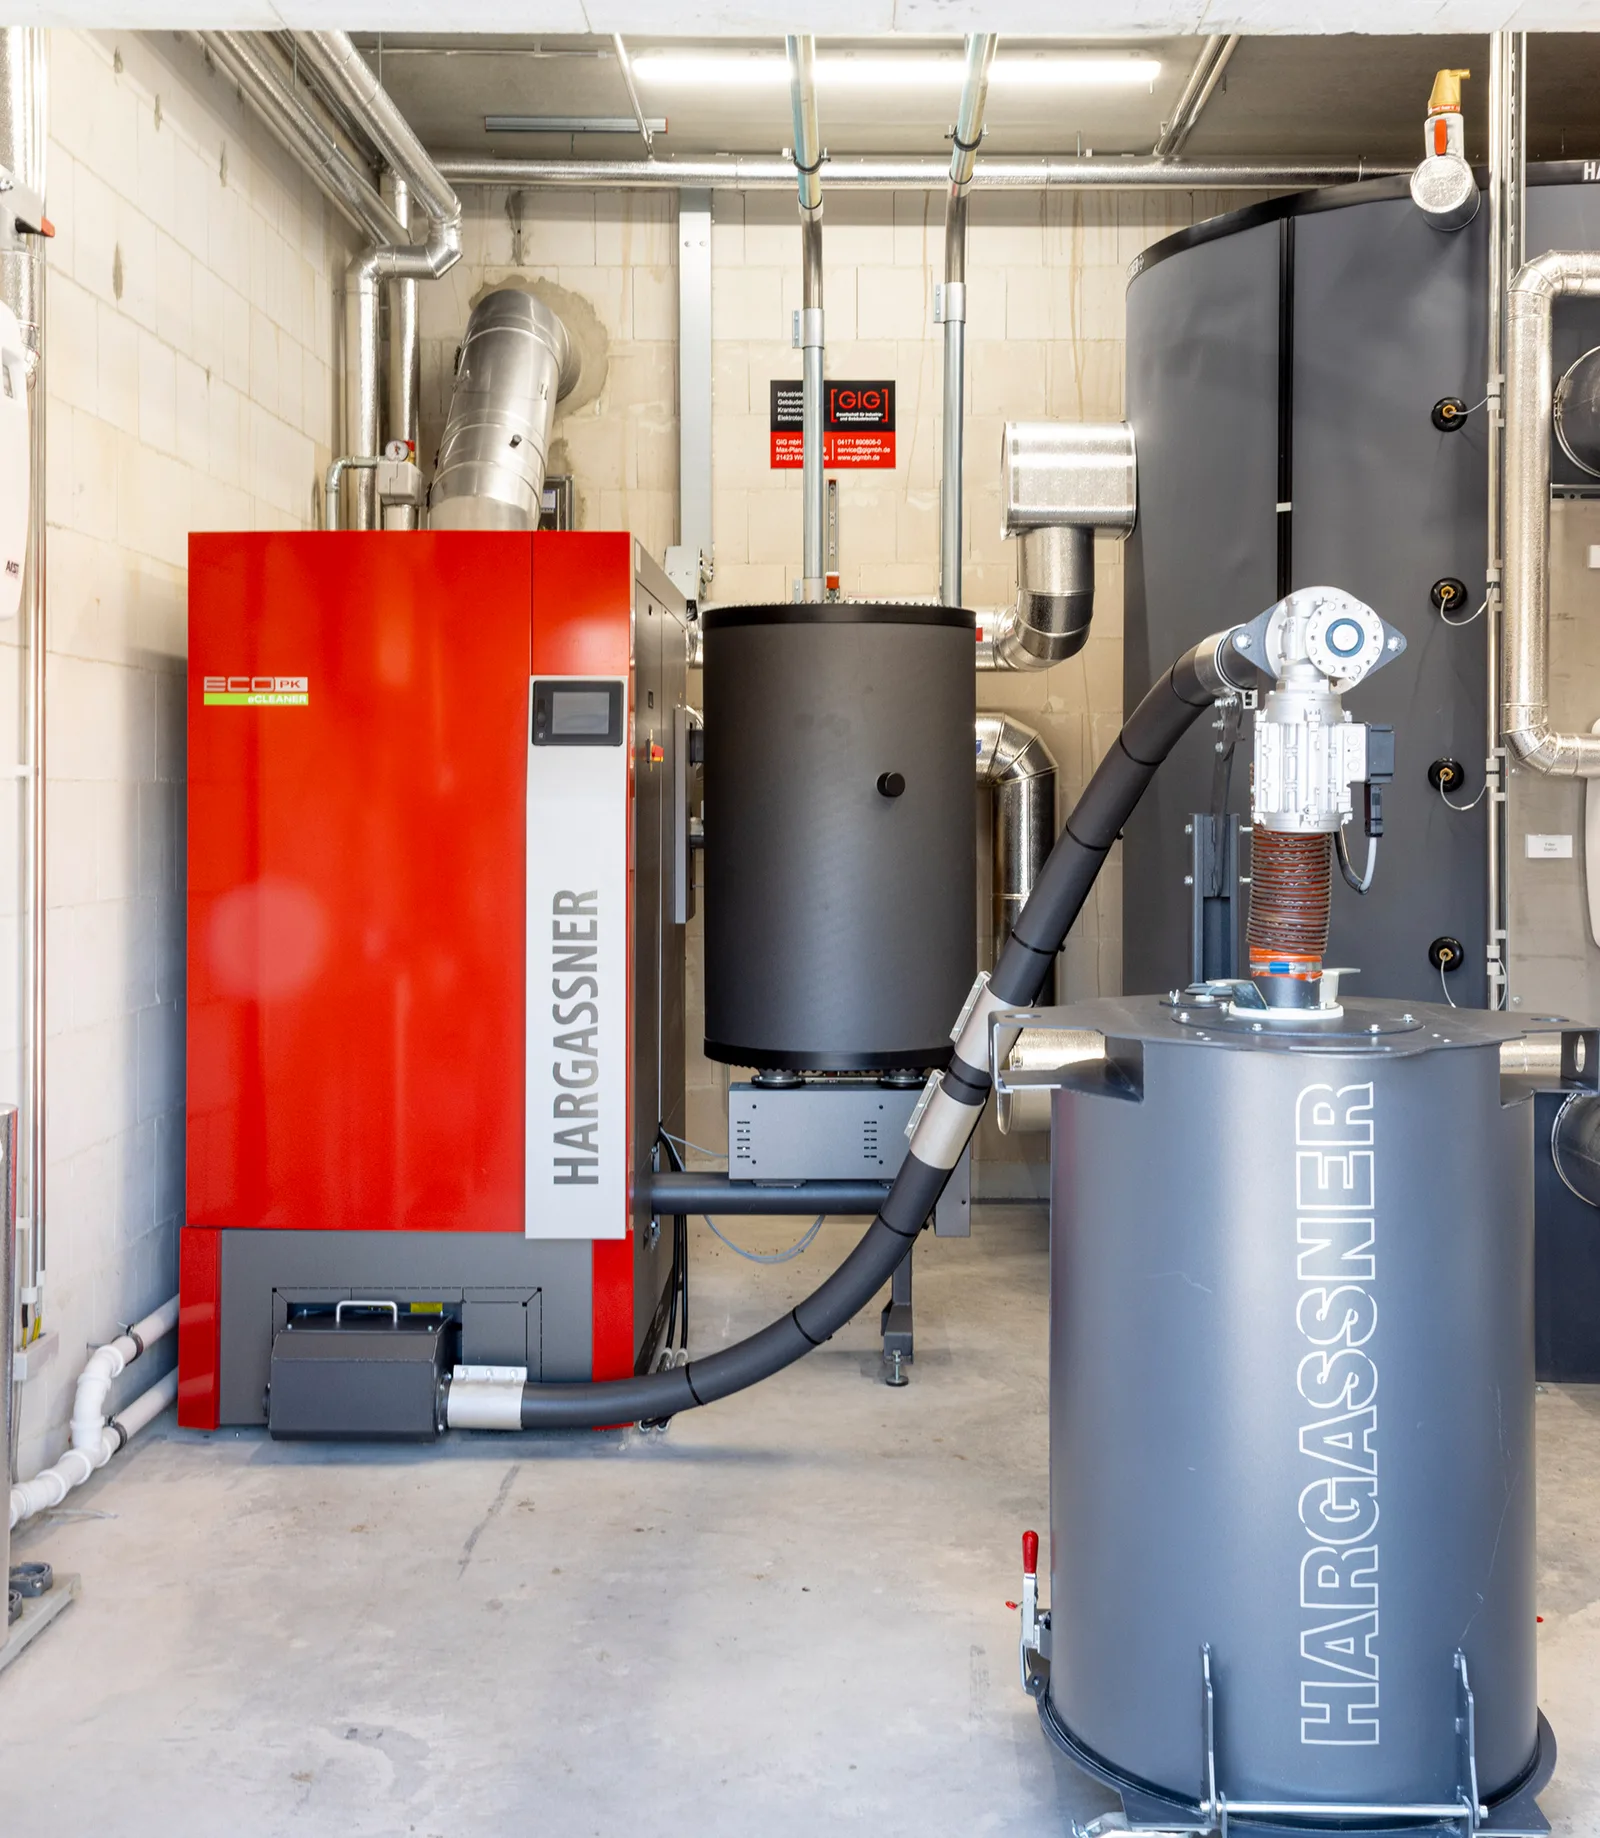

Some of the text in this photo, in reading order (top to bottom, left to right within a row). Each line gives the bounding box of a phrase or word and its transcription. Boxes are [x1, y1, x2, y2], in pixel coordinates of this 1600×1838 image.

[204, 677, 301, 692] ECO PK
[247, 694, 307, 704] eCLEANER
[552, 889, 599, 1185] HARGASSNER
[1296, 1081, 1380, 1745] HARGASSNER
